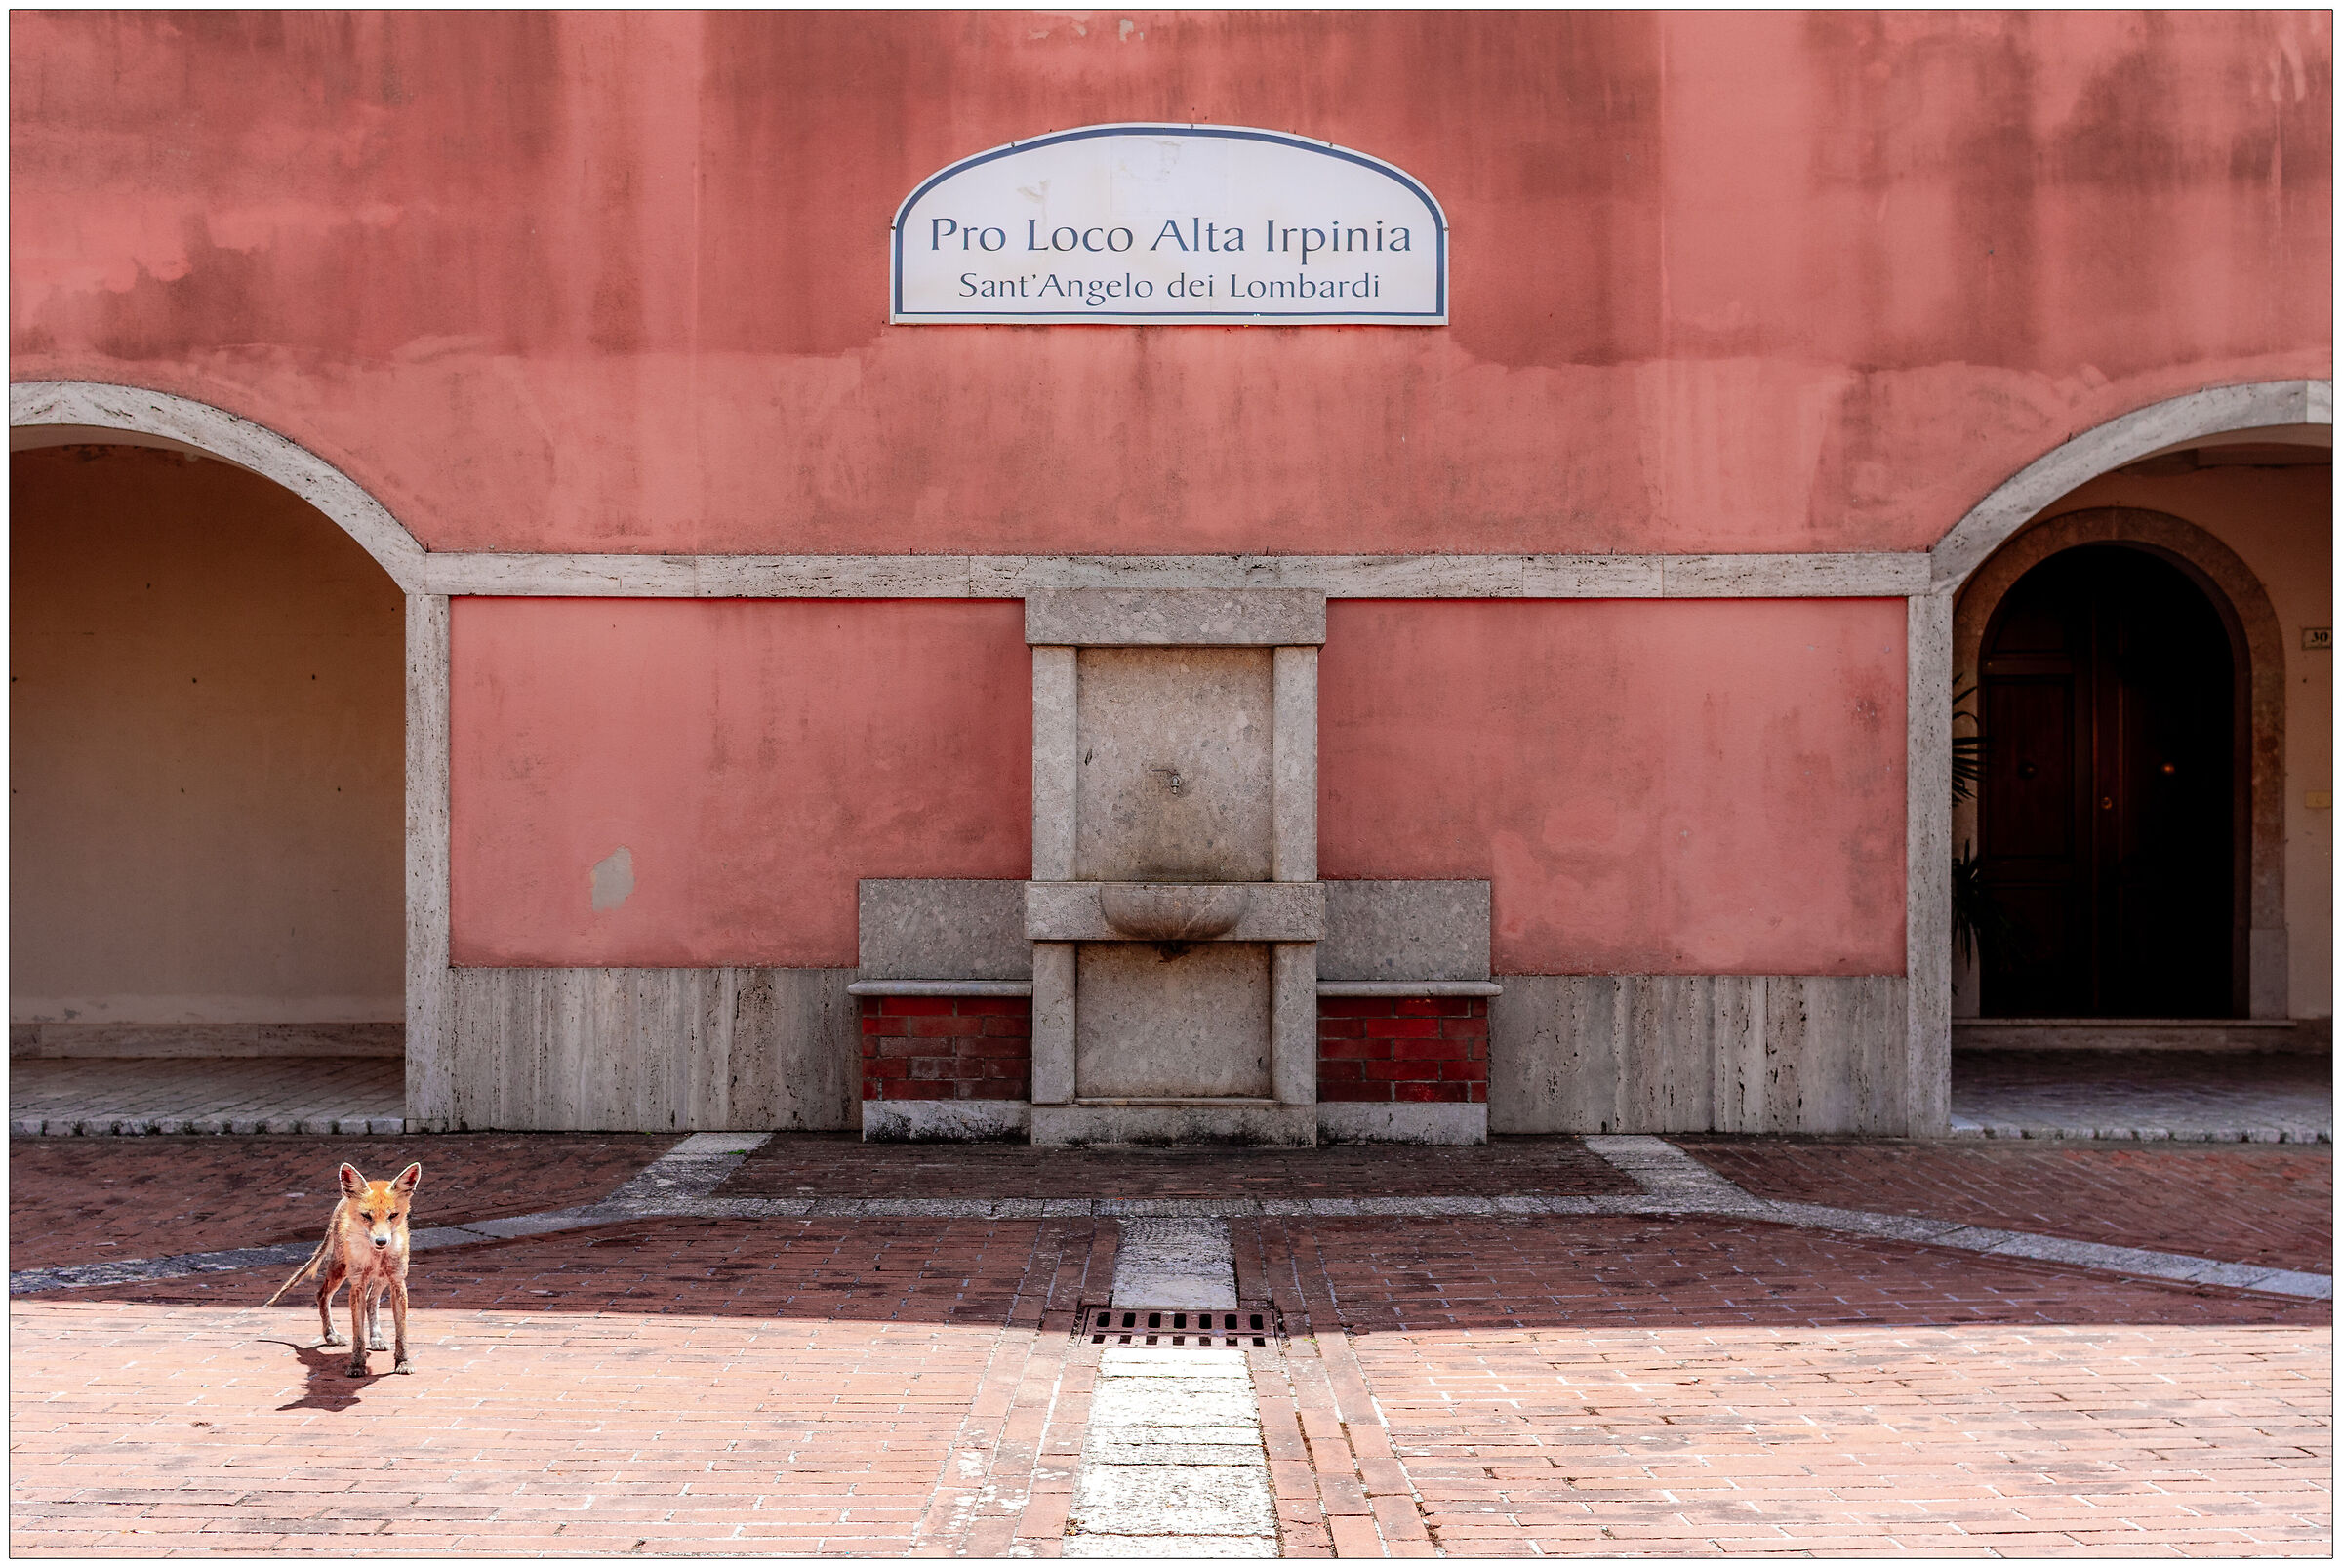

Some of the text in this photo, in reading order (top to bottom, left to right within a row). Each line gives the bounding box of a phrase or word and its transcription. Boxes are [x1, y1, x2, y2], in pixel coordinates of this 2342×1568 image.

[931, 218, 1410, 265] Pro Loco Alta Irpinia
[958, 273, 1378, 306] Sant'Angelo dei Lombardi
